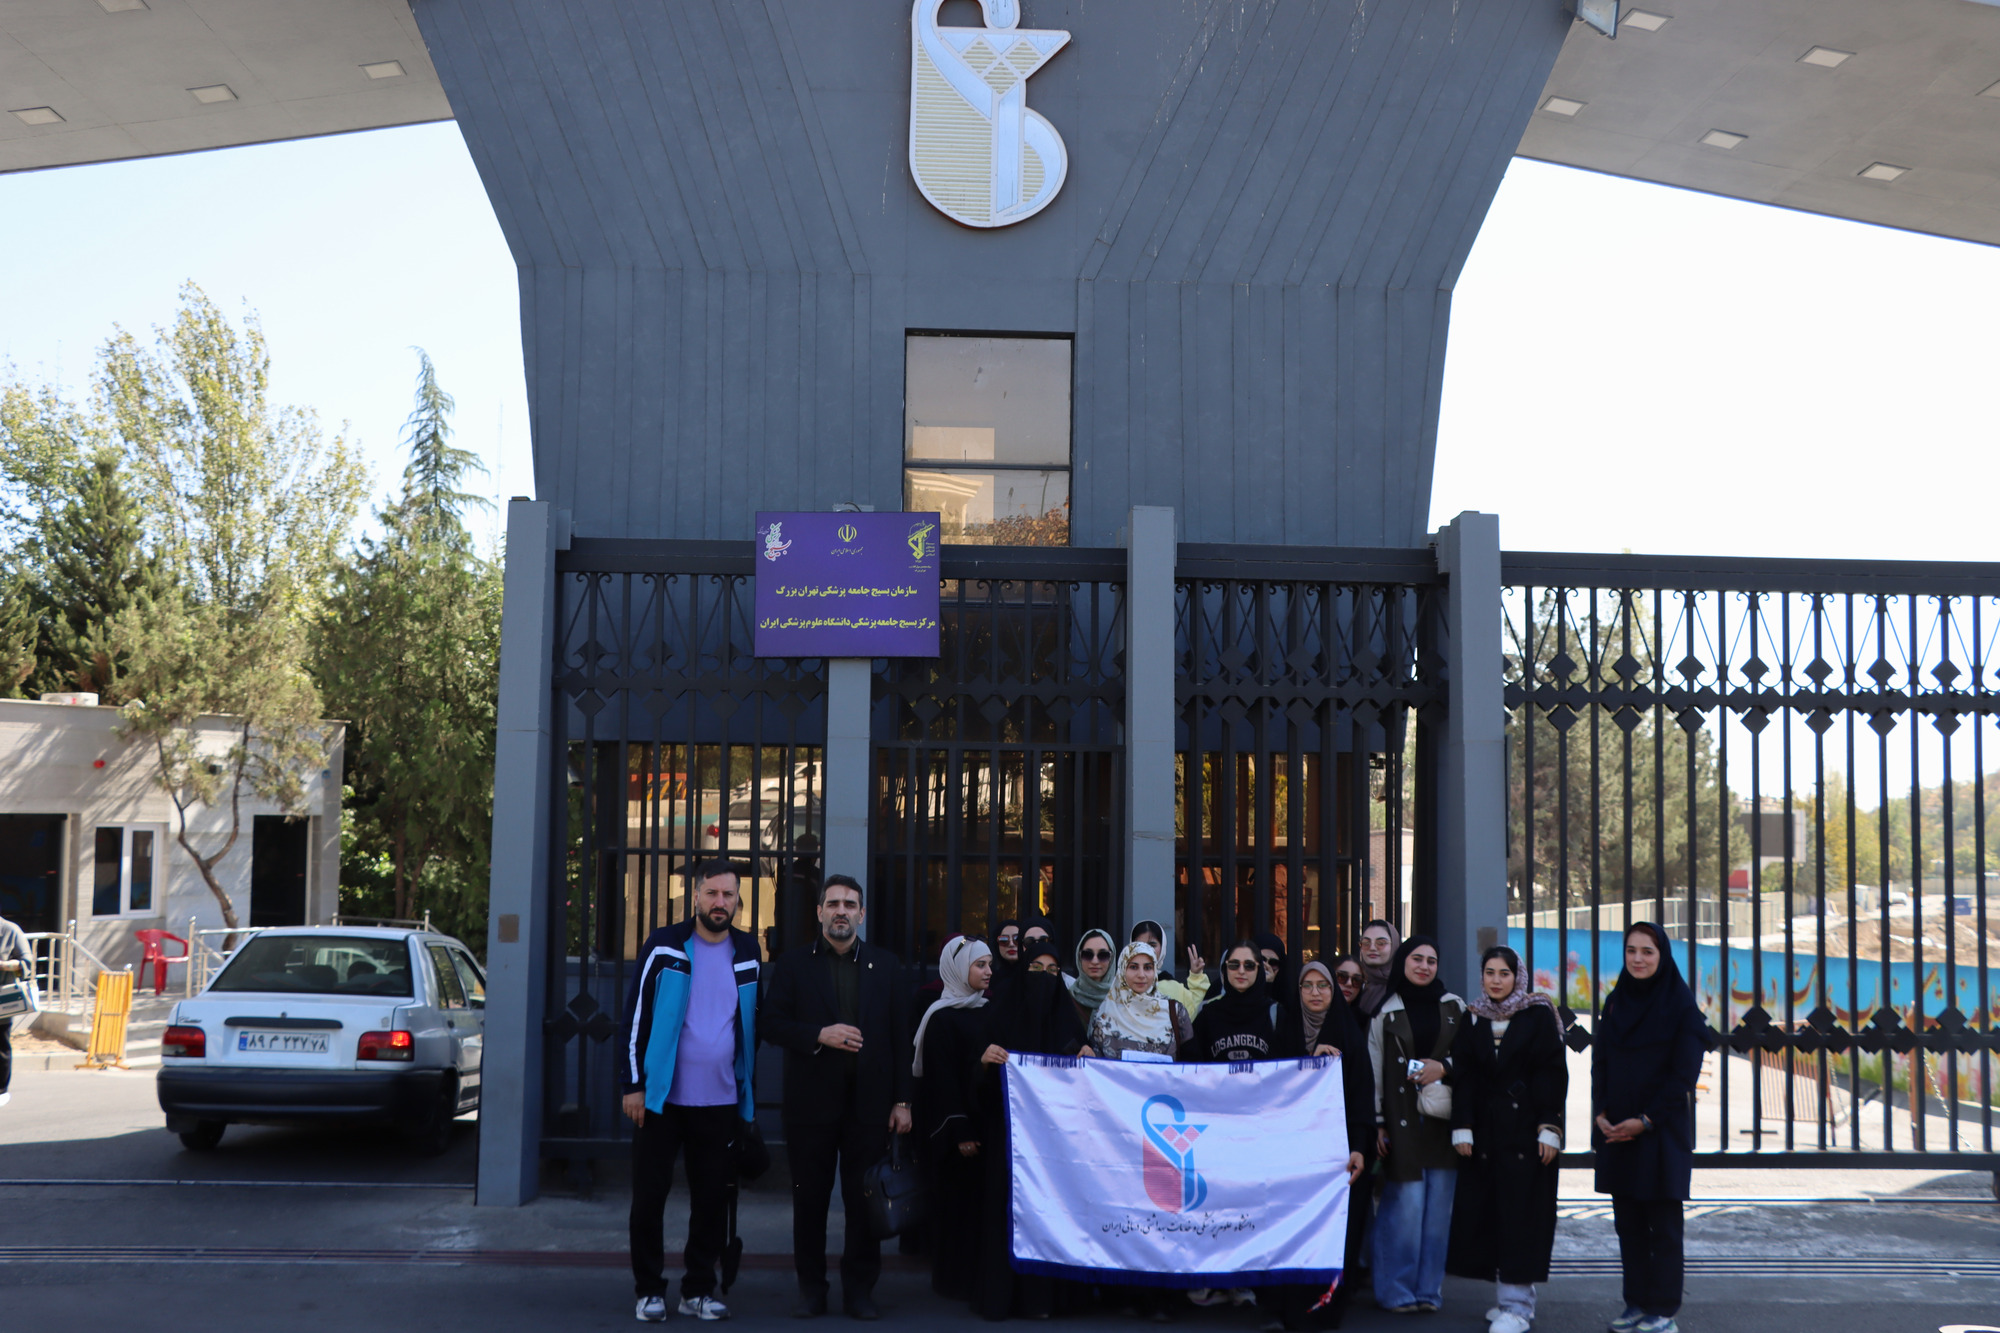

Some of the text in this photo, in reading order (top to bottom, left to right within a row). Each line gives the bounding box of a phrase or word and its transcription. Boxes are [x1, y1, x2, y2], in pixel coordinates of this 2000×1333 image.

[775, 585, 918, 597] سازمان بسیج جامعه پزشکی تهران بزرگ
[759, 616, 936, 629] مرکز بسیج جامعه پزشکی دانشگاه علوم پزشکی ایران
[1101, 1221, 1122, 1238] ایران
[1121, 1215, 1140, 1235] درمانی
[1166, 1219, 1192, 1232] خدمات
[1196, 1211, 1216, 1239] پزشکی
[1216, 1220, 1232, 1240] علوم
[1233, 1213, 1255, 1232] دانشگاه
